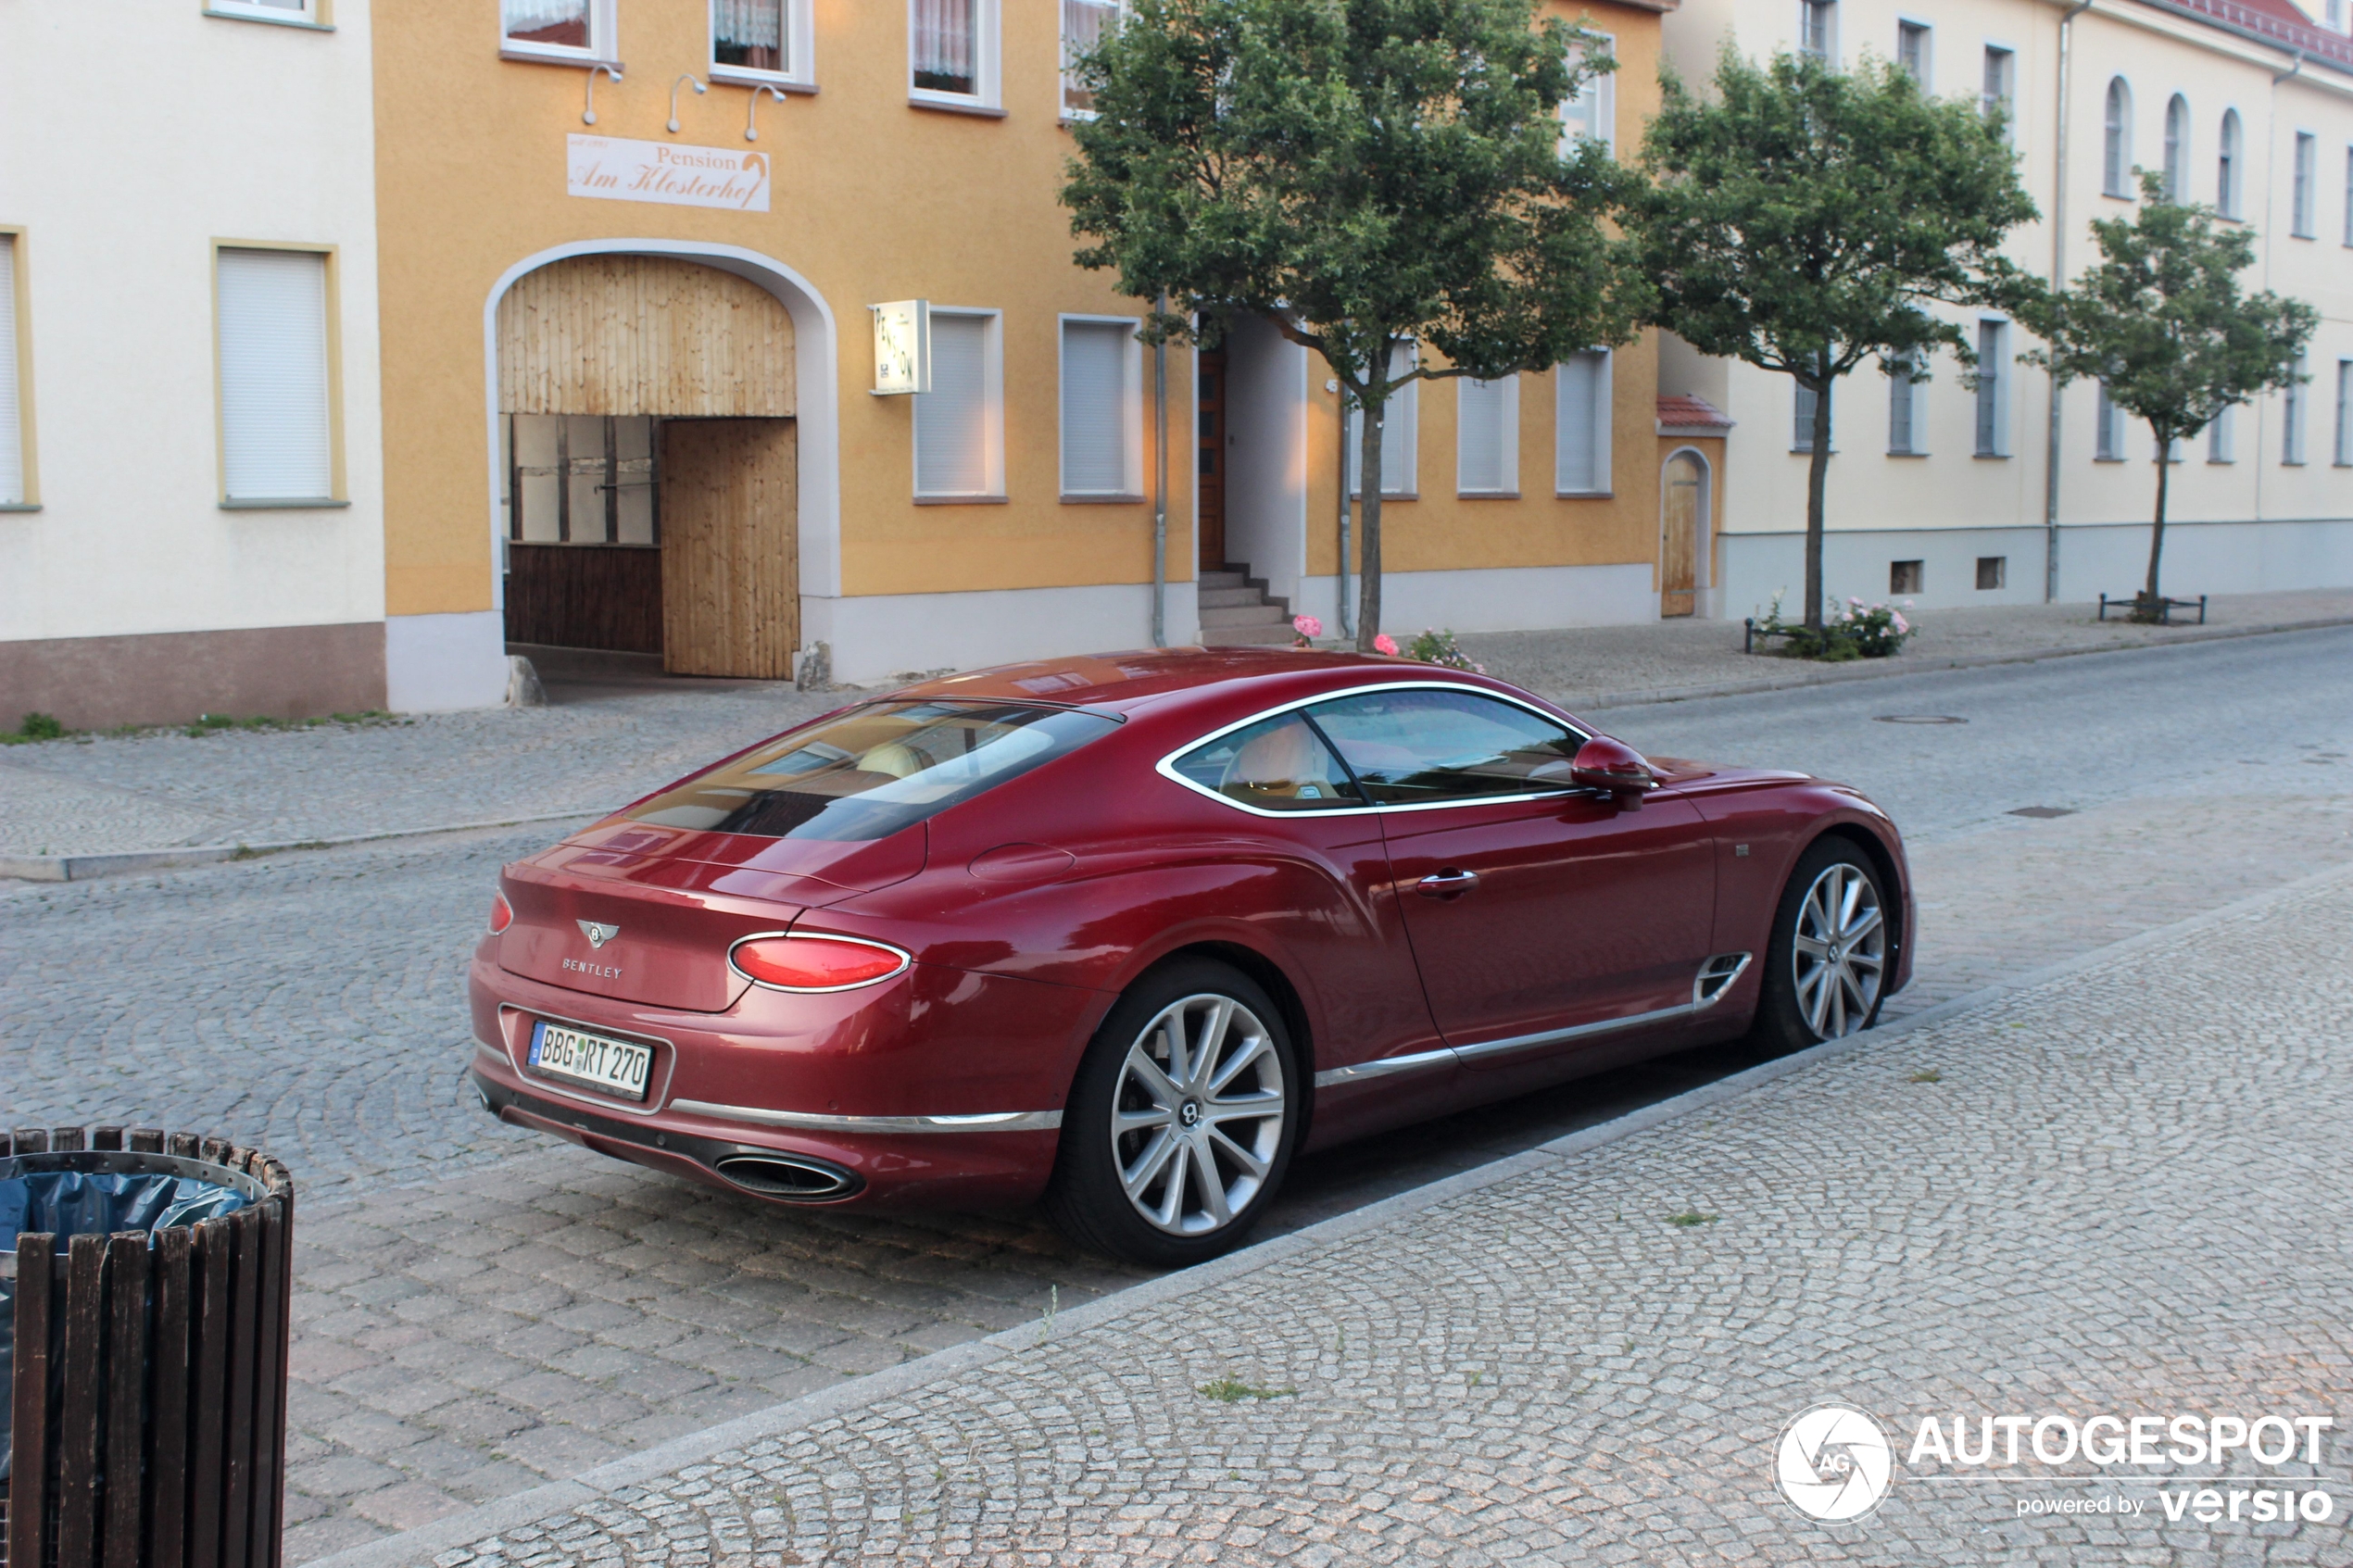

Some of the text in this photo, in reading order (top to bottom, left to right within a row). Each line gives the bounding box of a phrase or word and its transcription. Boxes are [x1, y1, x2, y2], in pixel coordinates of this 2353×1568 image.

[656, 146, 736, 170] Pension
[570, 161, 766, 208] Am Klosterhof
[562, 958, 623, 979] BENTLEY
[541, 1030, 576, 1067] BBG
[583, 1039, 609, 1075] RT
[609, 1046, 646, 1085] 270
